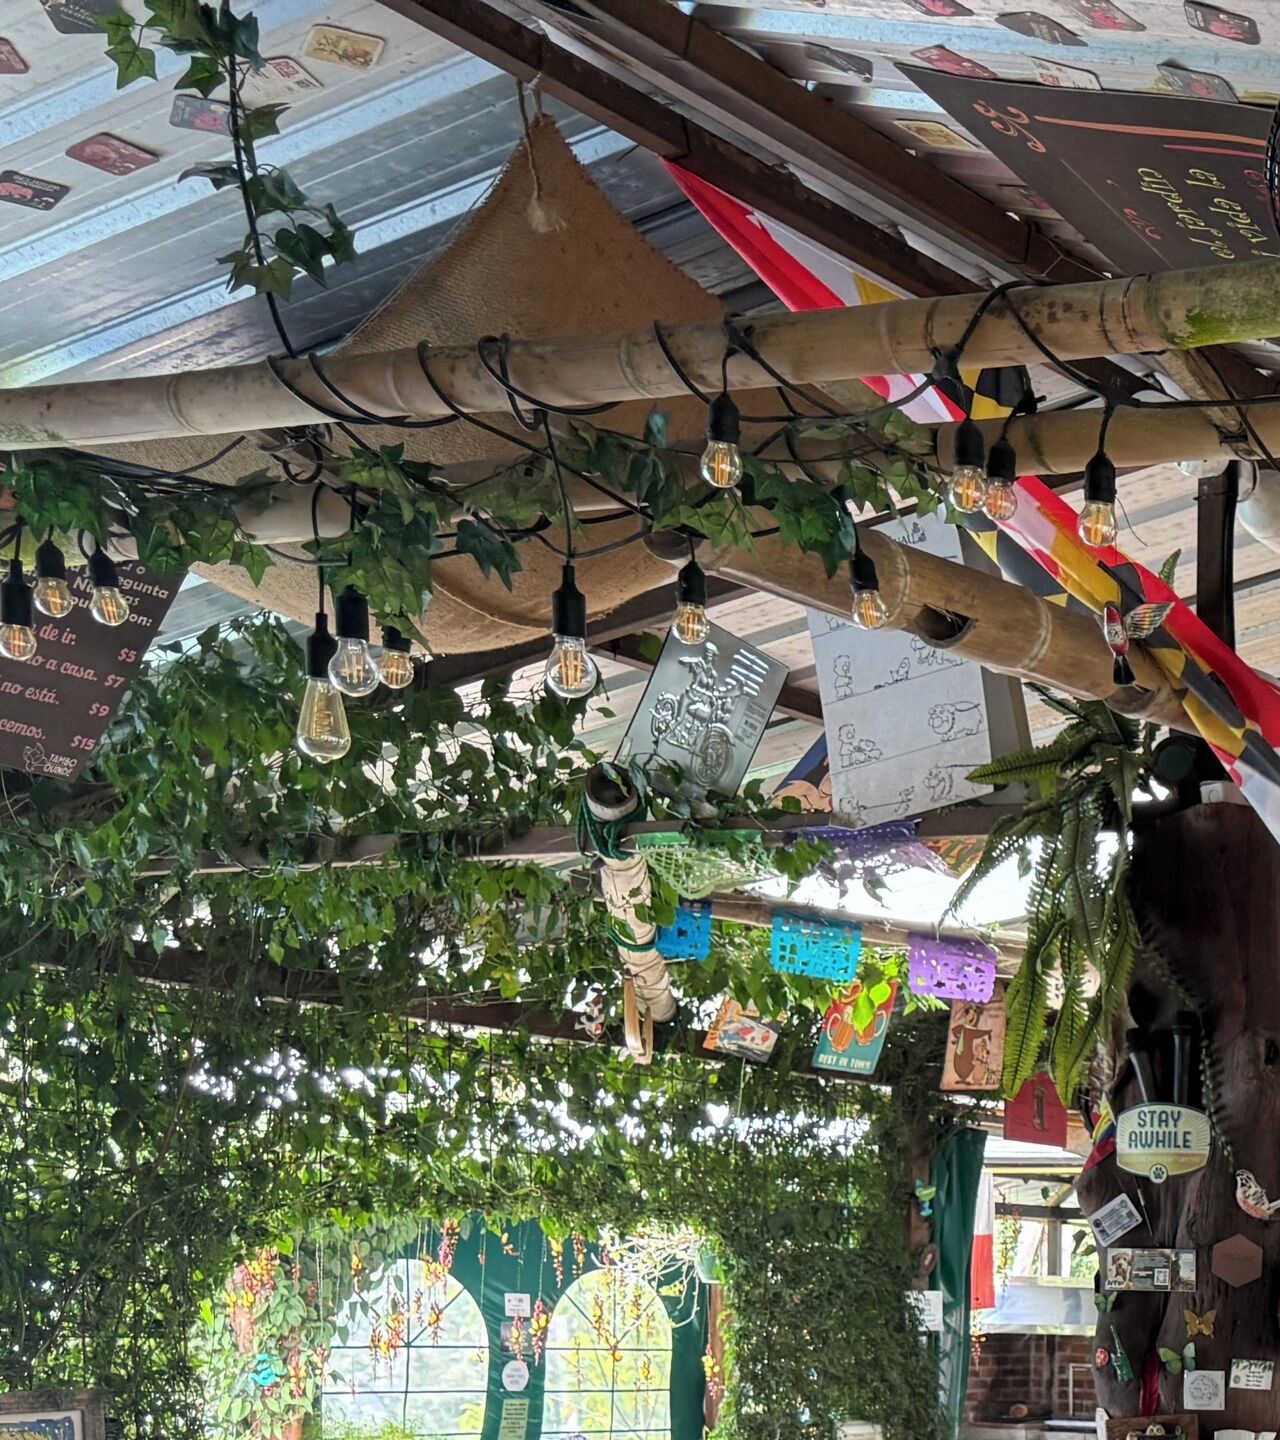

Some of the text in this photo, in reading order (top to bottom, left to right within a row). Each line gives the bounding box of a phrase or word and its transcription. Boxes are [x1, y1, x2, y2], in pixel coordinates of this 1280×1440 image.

[39, 624, 59, 641] de
[117, 647, 137, 663] $5
[60, 661, 98, 682] casa.
[104, 673, 125, 689] $7
[25, 685, 60, 705] está.
[88, 702, 109, 717] $9
[70, 734, 96, 751] $15
[49, 753, 78, 768] TAMBO
[1138, 1110, 1182, 1128] STAY
[1128, 1131, 1192, 1149] AWHILE
